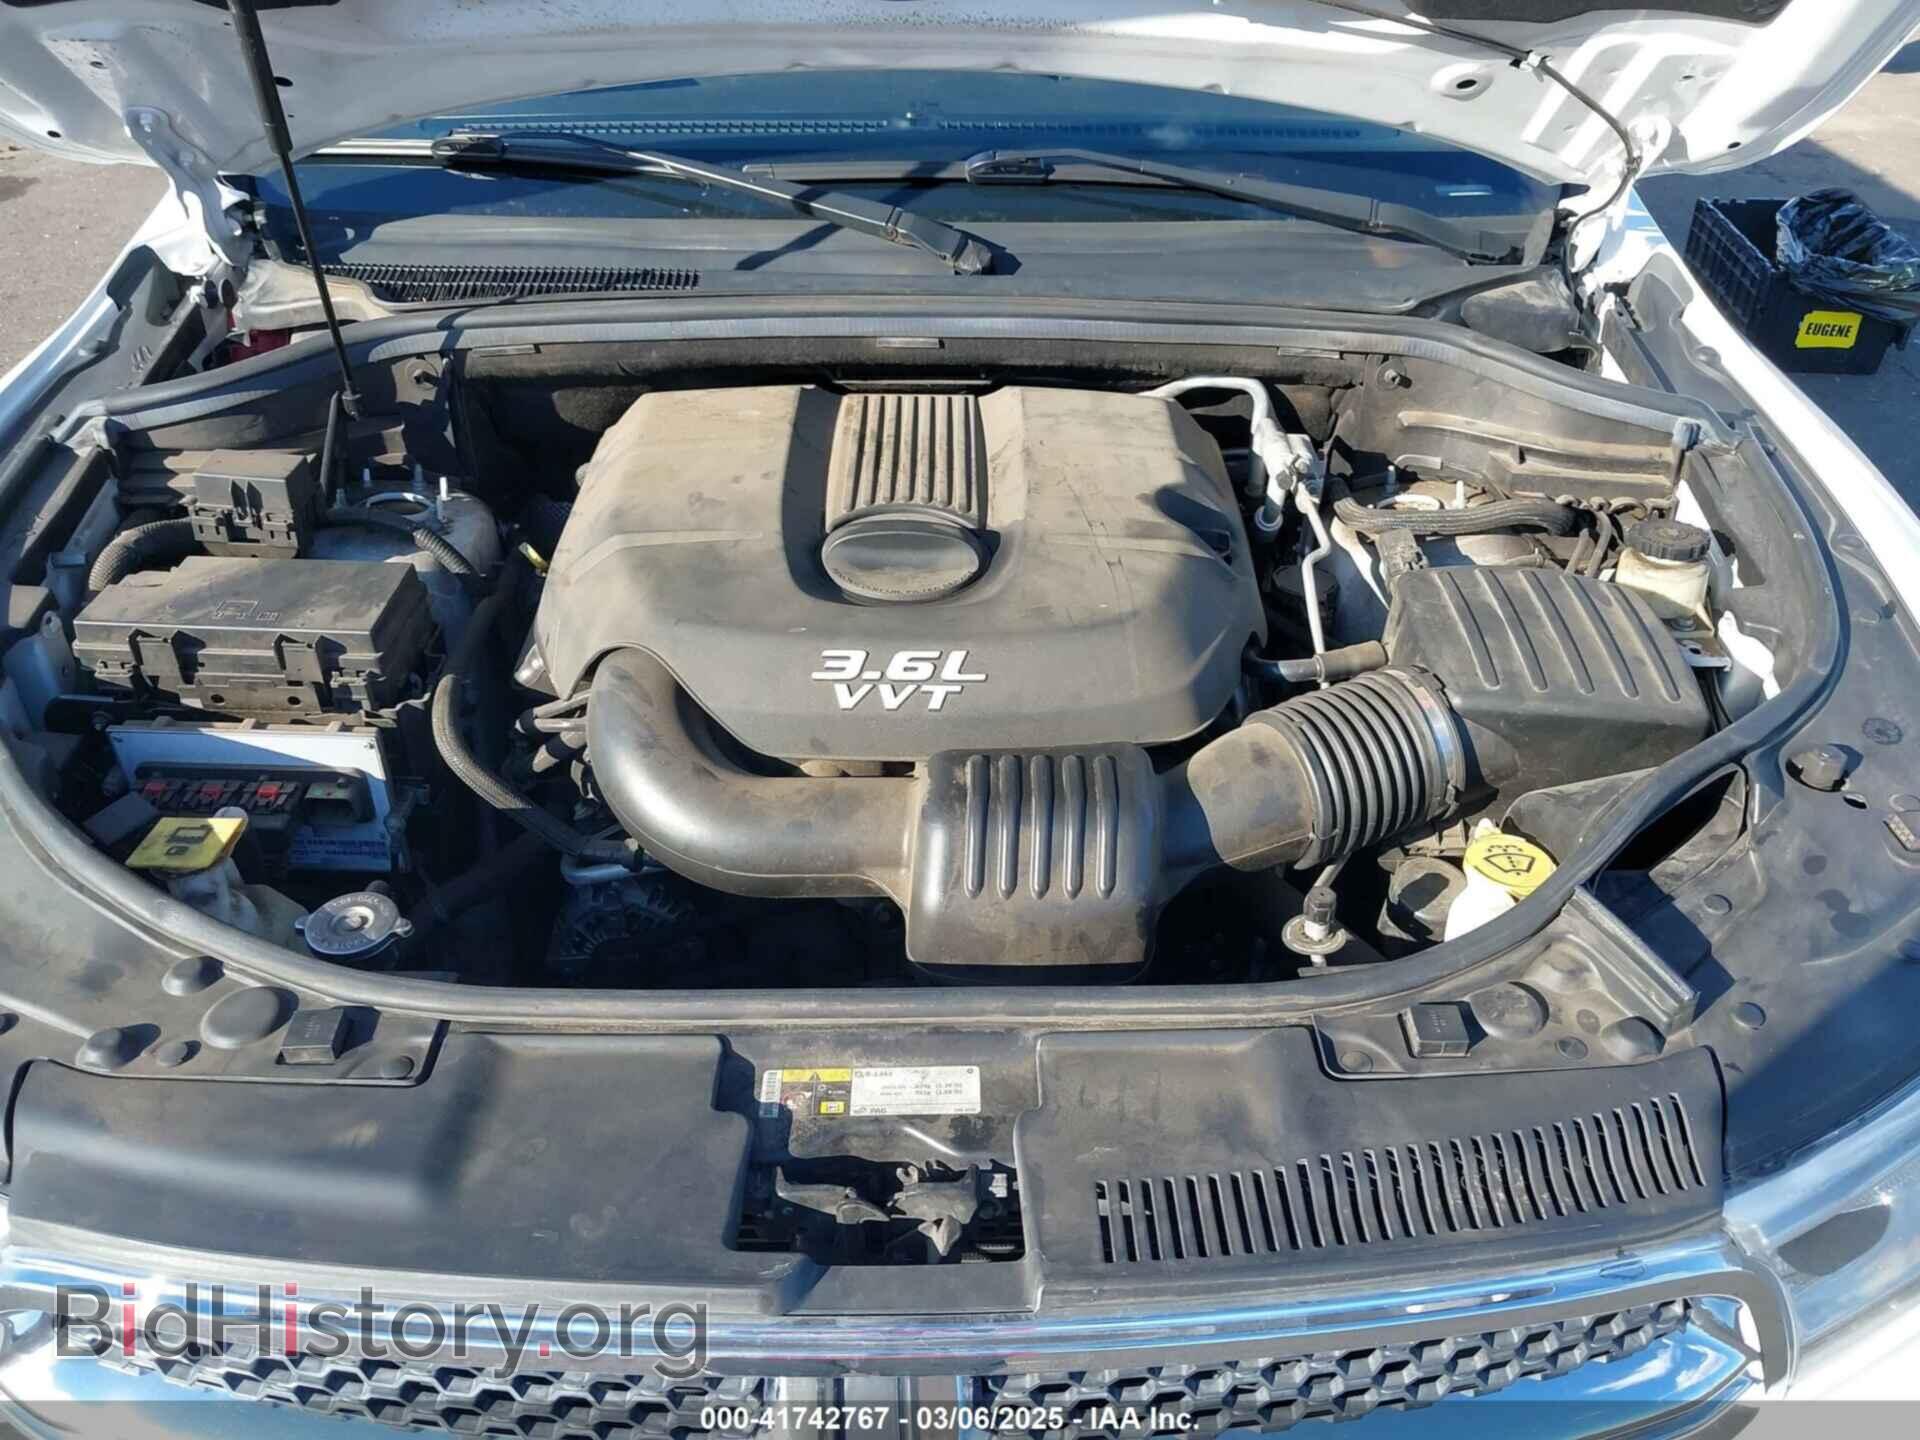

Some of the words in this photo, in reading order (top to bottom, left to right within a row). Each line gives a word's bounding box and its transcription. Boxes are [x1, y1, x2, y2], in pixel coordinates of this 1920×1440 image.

[1805, 322, 1853, 338] EUGENE
[811, 649, 989, 682] 3.6L
[833, 683, 964, 711] VVT
